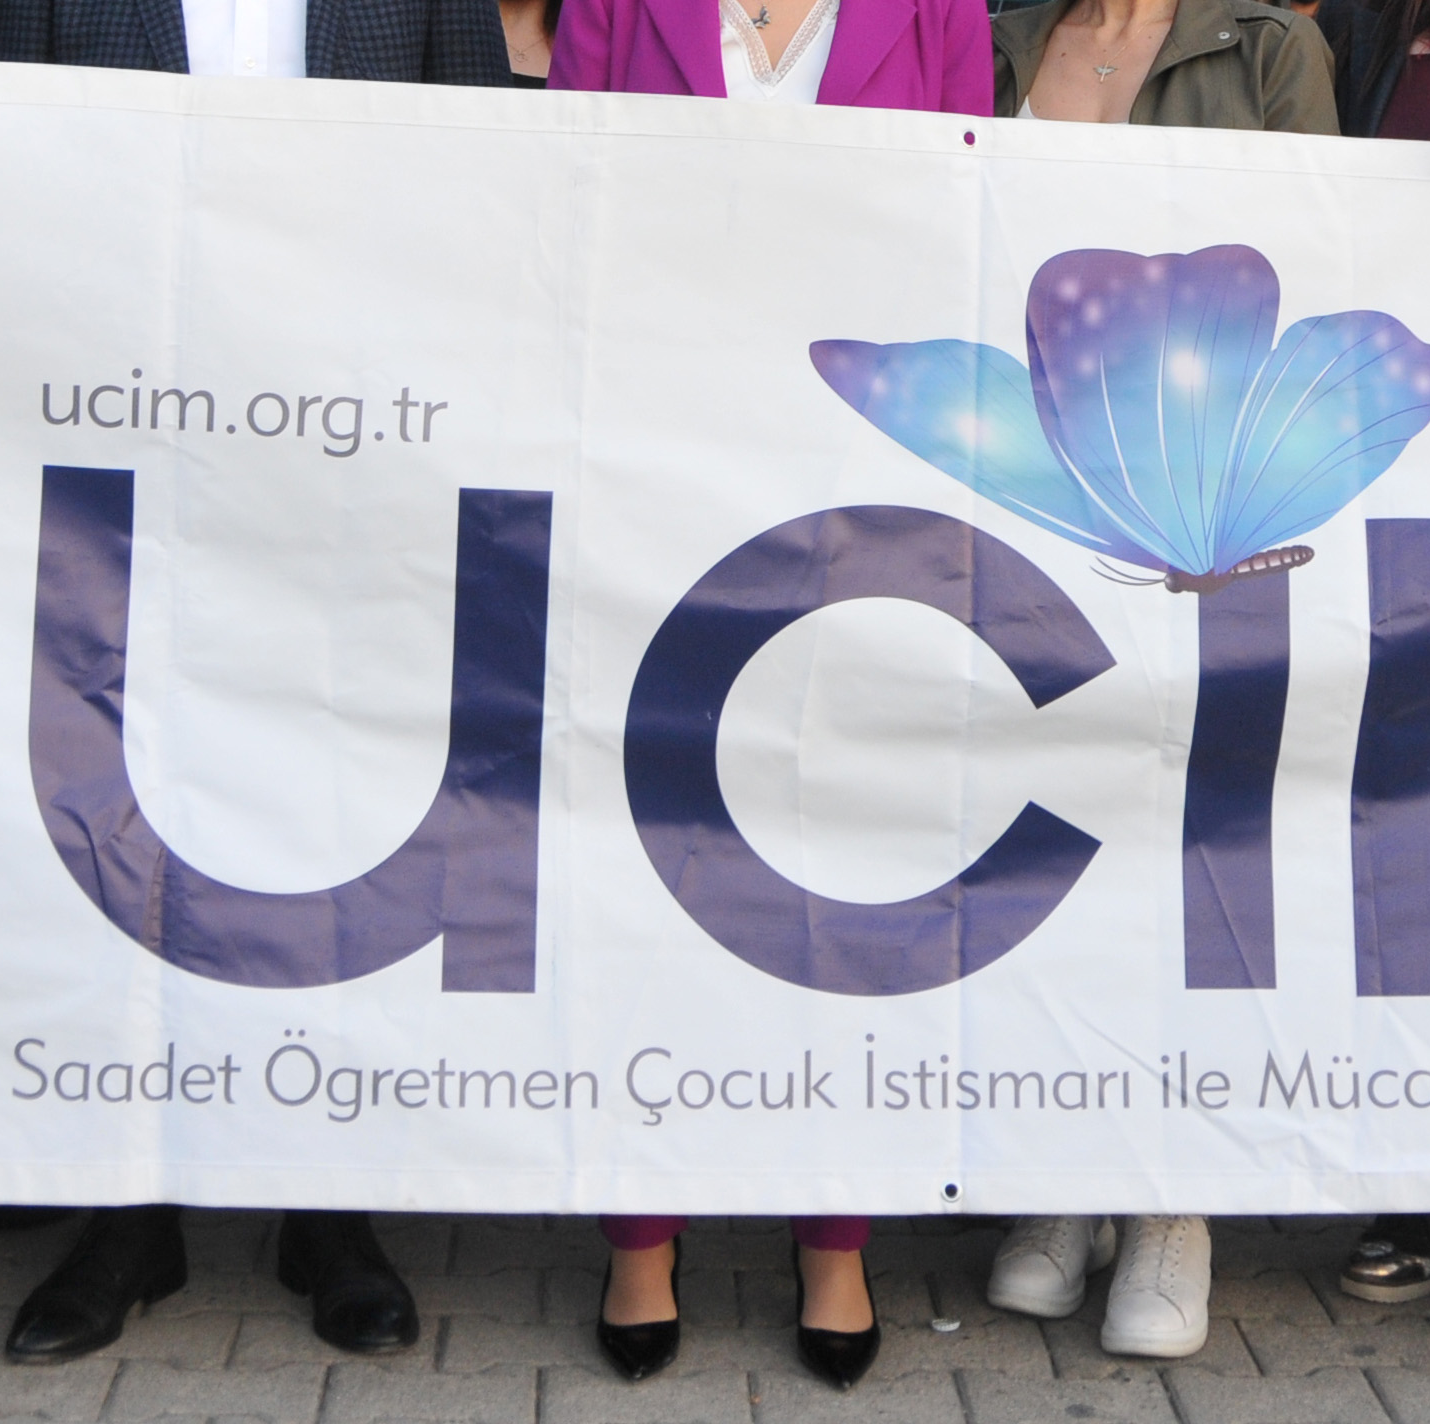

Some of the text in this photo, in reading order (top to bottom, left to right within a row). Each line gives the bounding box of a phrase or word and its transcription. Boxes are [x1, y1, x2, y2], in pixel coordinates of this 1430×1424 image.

[42, 367, 448, 458] ucim.org.tr
[10, 1037, 241, 1104] Saadet
[265, 1028, 600, 1123] Ögretmen
[625, 1045, 834, 1127] Çocuk
[864, 1033, 1130, 1110] İstismarı
[1160, 1050, 1231, 1110] ile
